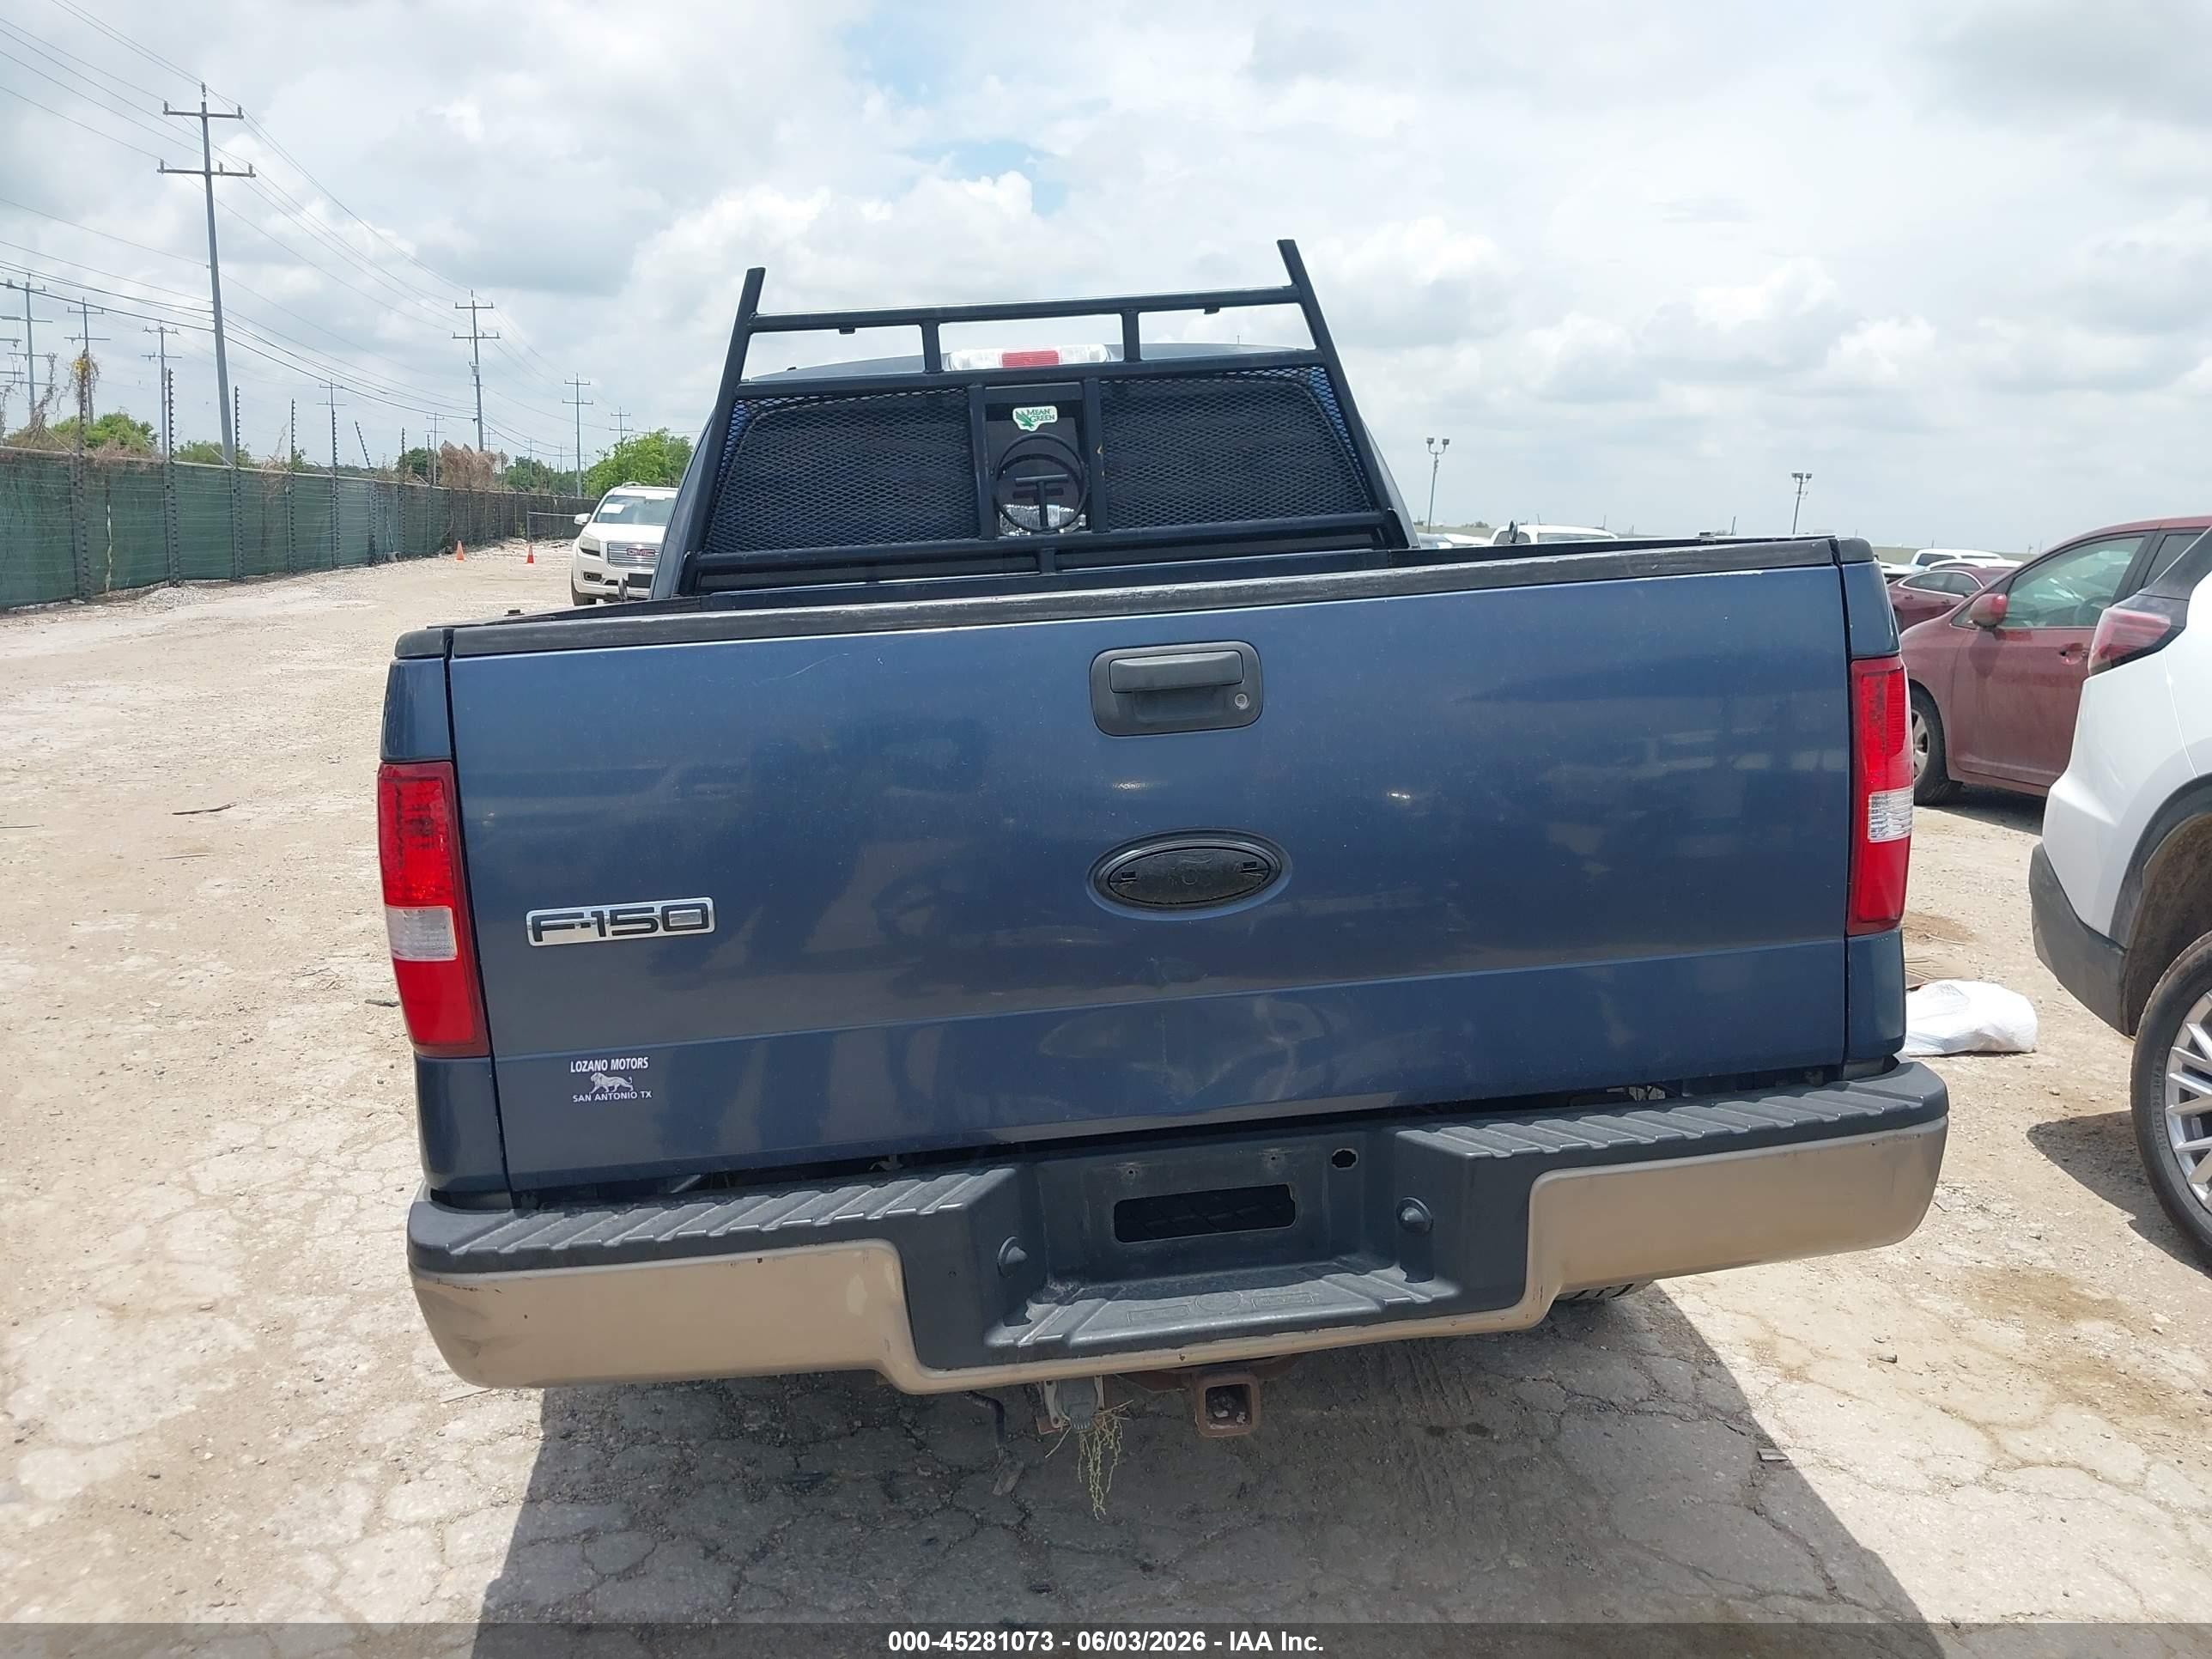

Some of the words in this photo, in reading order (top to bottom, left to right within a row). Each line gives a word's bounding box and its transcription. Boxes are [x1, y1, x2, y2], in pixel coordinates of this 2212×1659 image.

[627, 548, 655, 556] GMC
[531, 902, 710, 943] F-150
[570, 1059, 608, 1073] LOZANO
[611, 1057, 648, 1071] MOTORS
[572, 1094, 592, 1103] SAN
[594, 1091, 637, 1101] ANTONIO
